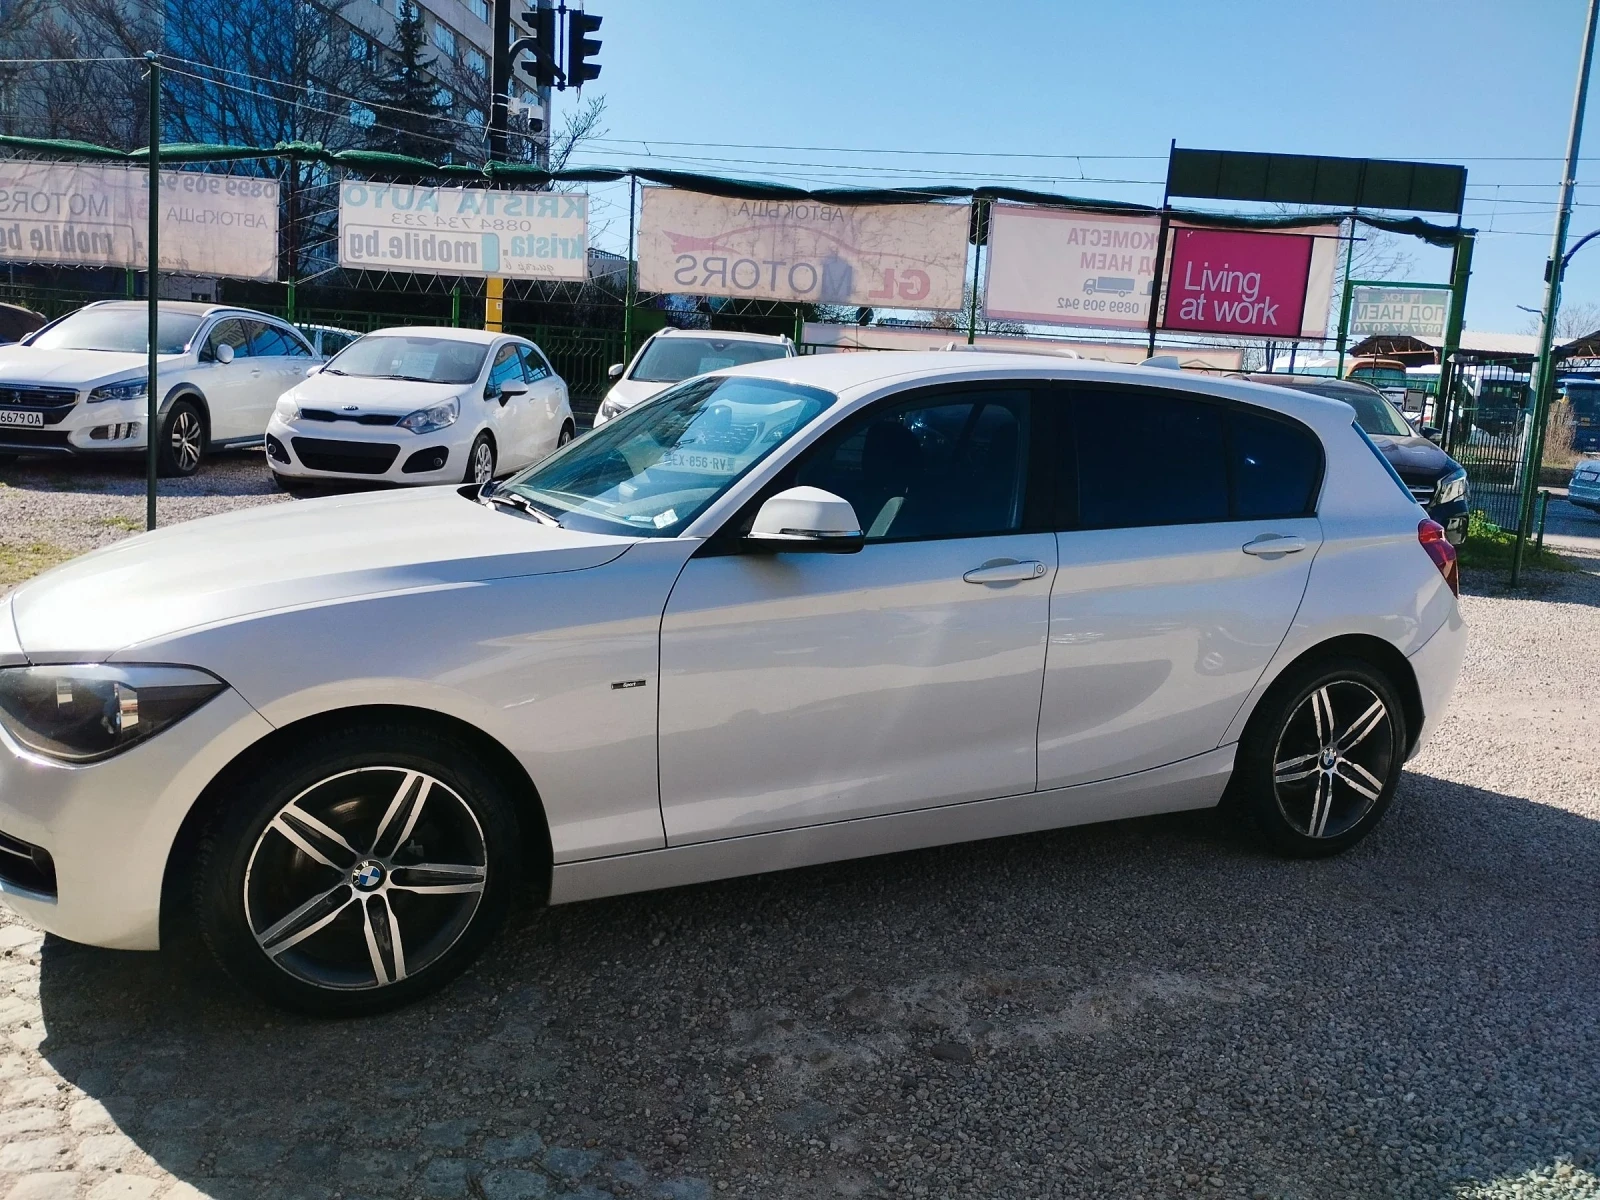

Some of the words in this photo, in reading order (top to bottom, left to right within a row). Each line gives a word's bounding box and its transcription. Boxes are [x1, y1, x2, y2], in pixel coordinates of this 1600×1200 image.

[1184, 260, 1261, 303] Living
[1179, 293, 1206, 322] at
[1212, 296, 1280, 327] work
[0, 411, 25, 424] 6679
